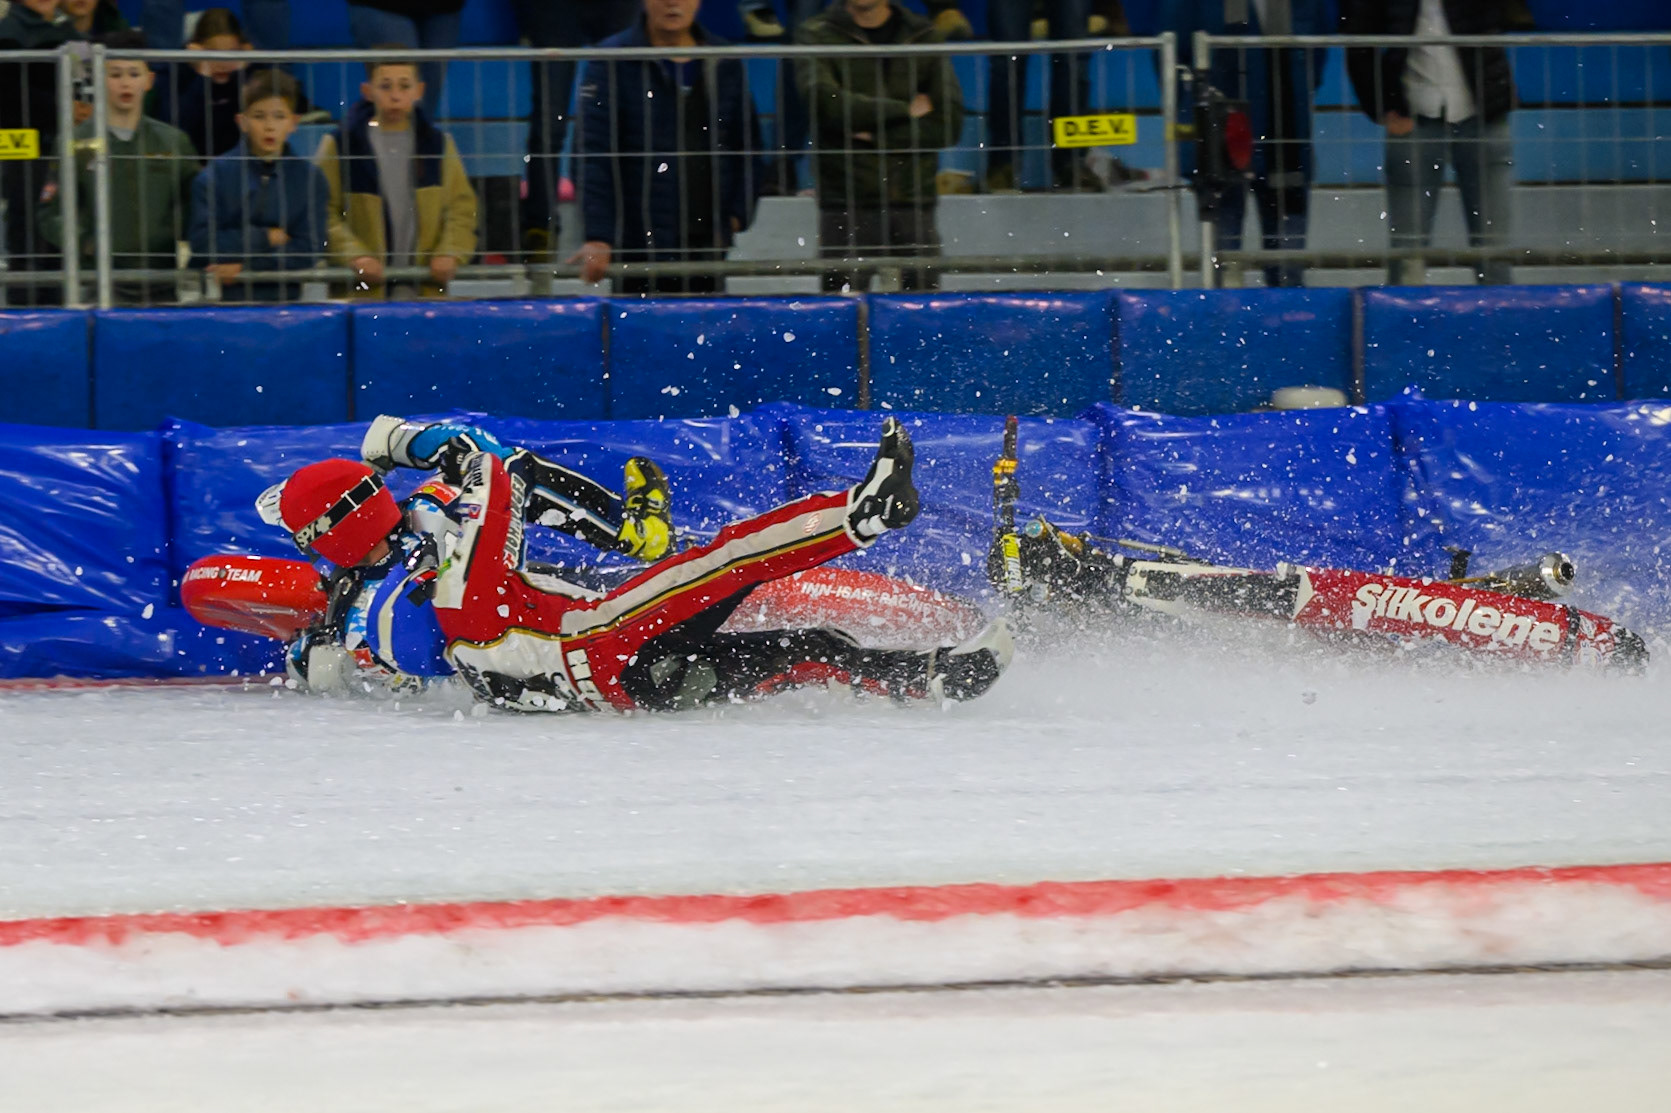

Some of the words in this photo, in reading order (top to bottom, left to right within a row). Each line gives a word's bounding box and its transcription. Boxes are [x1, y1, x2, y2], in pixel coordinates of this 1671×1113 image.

[1064, 118, 1129, 137] D.E.V.
[294, 522, 316, 548] SPY
[226, 568, 263, 583] TEAM
[1351, 583, 1561, 651] Silkolene
